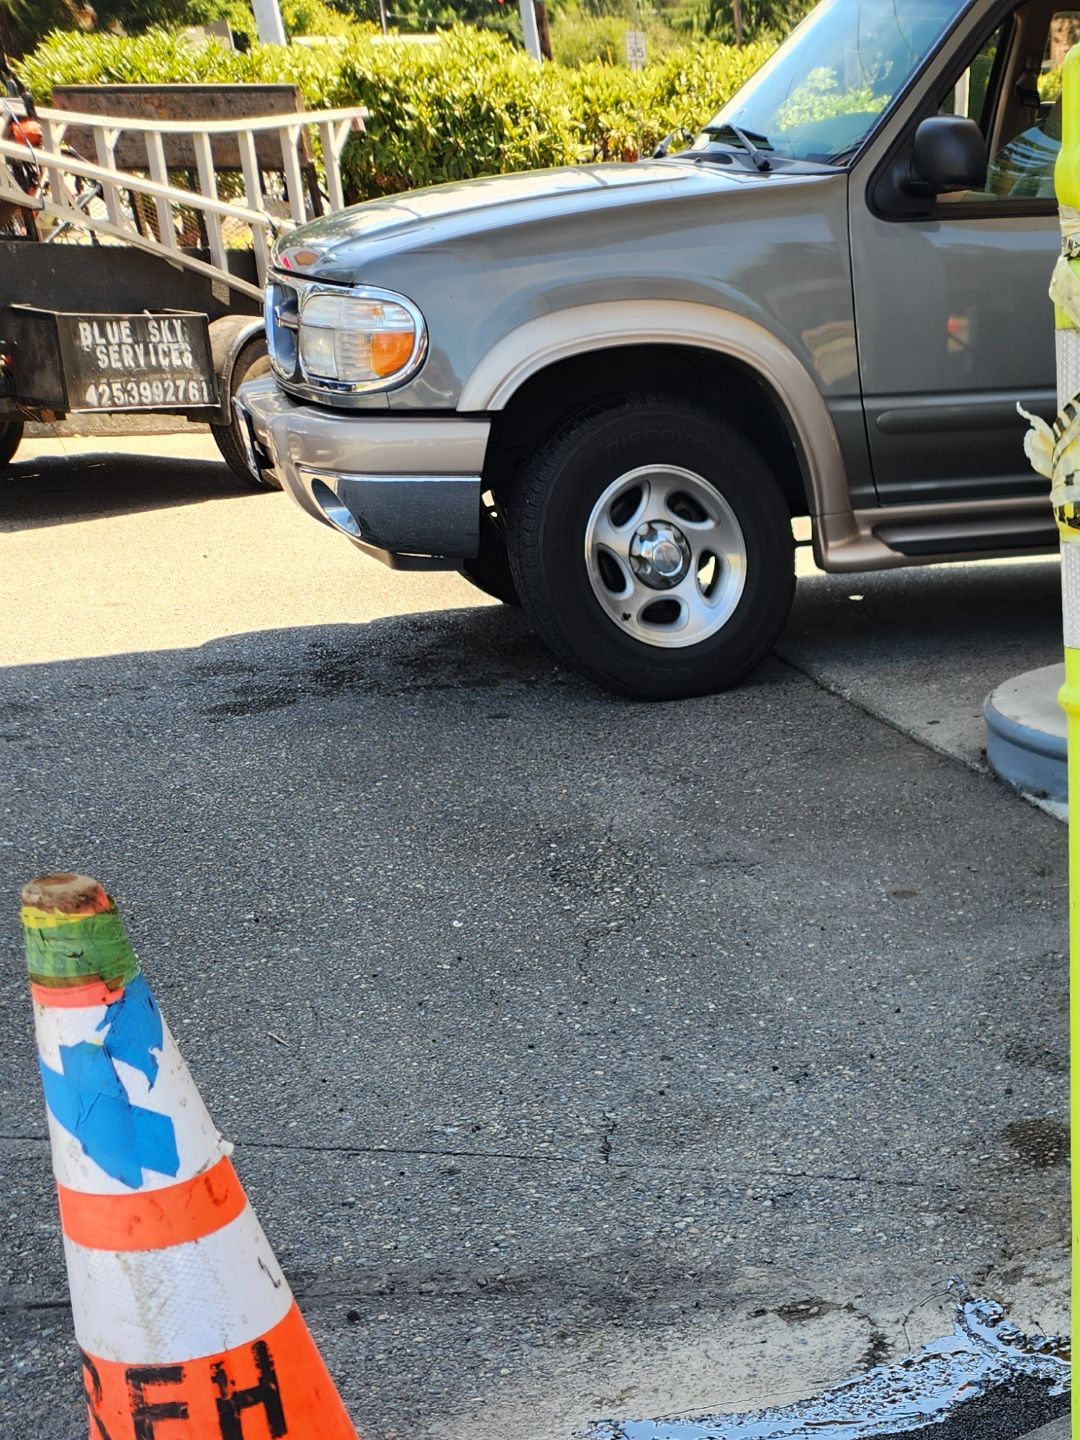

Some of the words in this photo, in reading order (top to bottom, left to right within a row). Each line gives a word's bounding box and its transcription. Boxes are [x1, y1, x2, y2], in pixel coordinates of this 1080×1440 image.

[78, 320, 133, 349] BLUE
[148, 318, 184, 344] SKY
[96, 343, 193, 369] SERVICES
